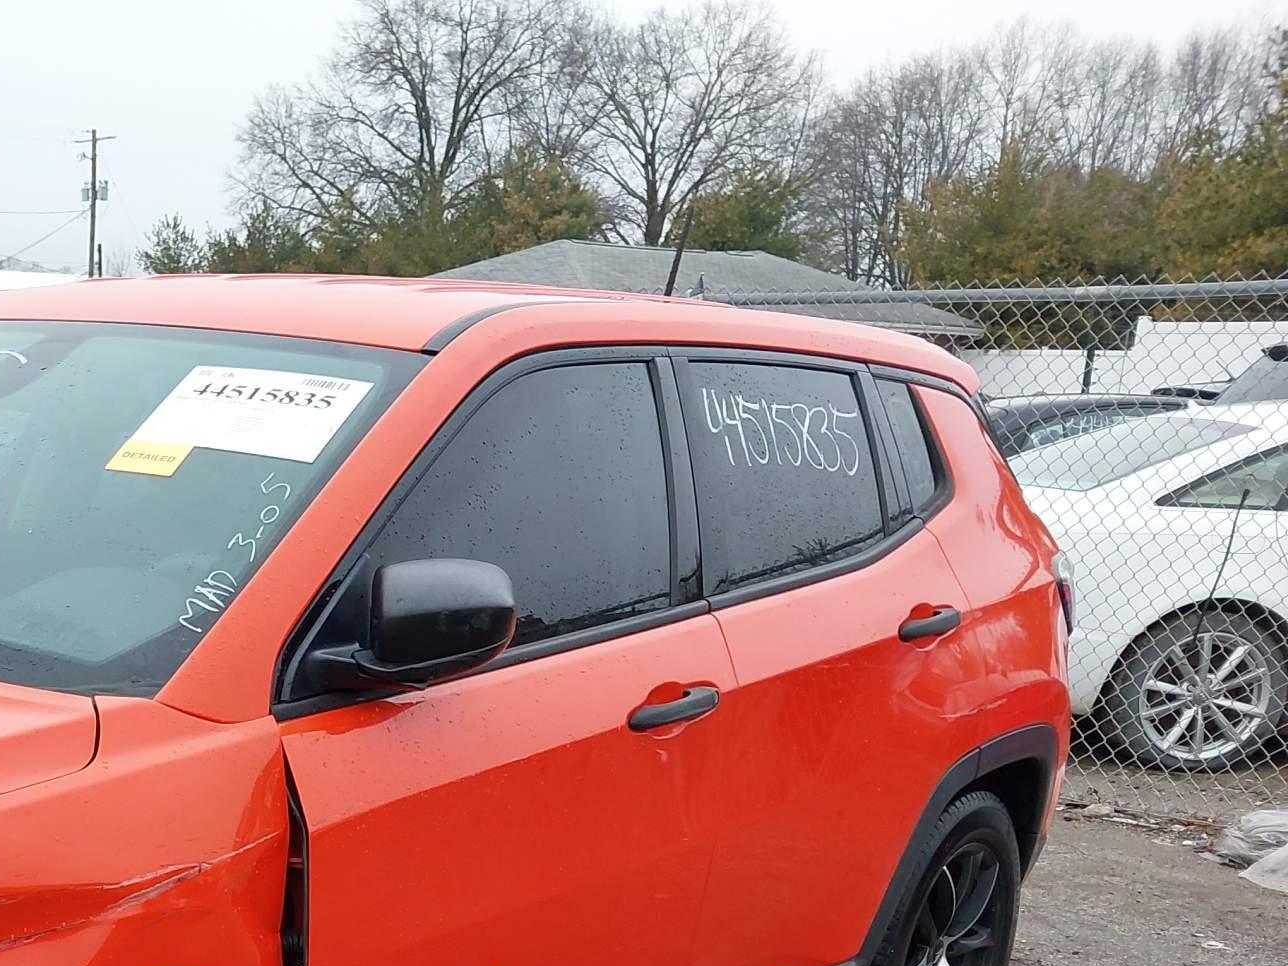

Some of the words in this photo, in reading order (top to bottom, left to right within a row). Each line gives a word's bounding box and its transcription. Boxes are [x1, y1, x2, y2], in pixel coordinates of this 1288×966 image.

[193, 382, 337, 410] 44515835
[121, 450, 177, 464] DETAILED
[702, 387, 860, 476] 44515835
[179, 569, 238, 633] MAD
[227, 471, 291, 563] 3-05
